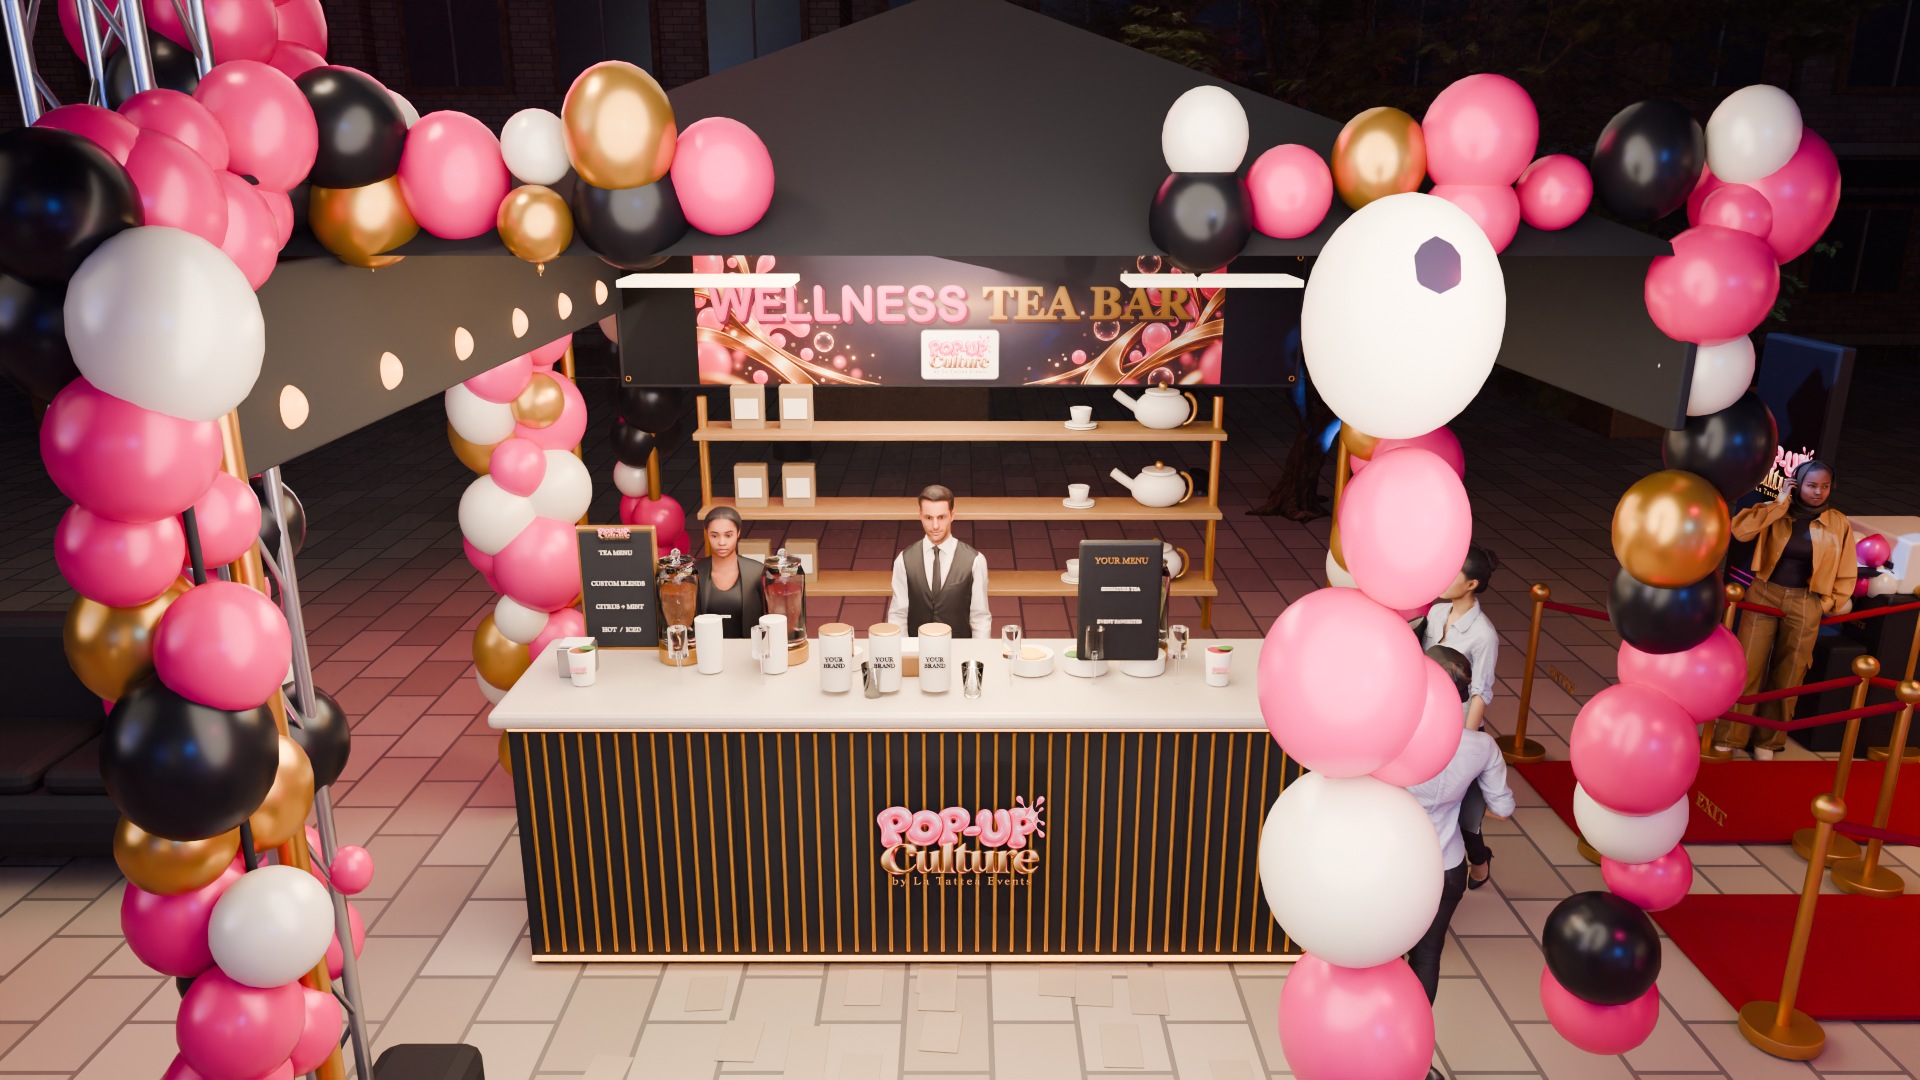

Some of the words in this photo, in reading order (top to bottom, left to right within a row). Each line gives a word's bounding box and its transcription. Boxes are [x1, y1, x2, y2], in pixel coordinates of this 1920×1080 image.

[708, 284, 970, 325] WELLNESS
[982, 285, 1081, 322] TEA
[1088, 286, 1195, 323] BAR
[928, 339, 988, 357] POP-UP
[929, 354, 990, 369] Culture
[1095, 556, 1121, 564] YOUR
[1122, 556, 1149, 564] MENU
[1696, 790, 1728, 827] EXIT
[877, 804, 1039, 848] POP-UP
[880, 842, 1040, 875] Culture
[892, 876, 907, 887] by
[914, 876, 930, 886] La
[987, 876, 1031, 886] Events
